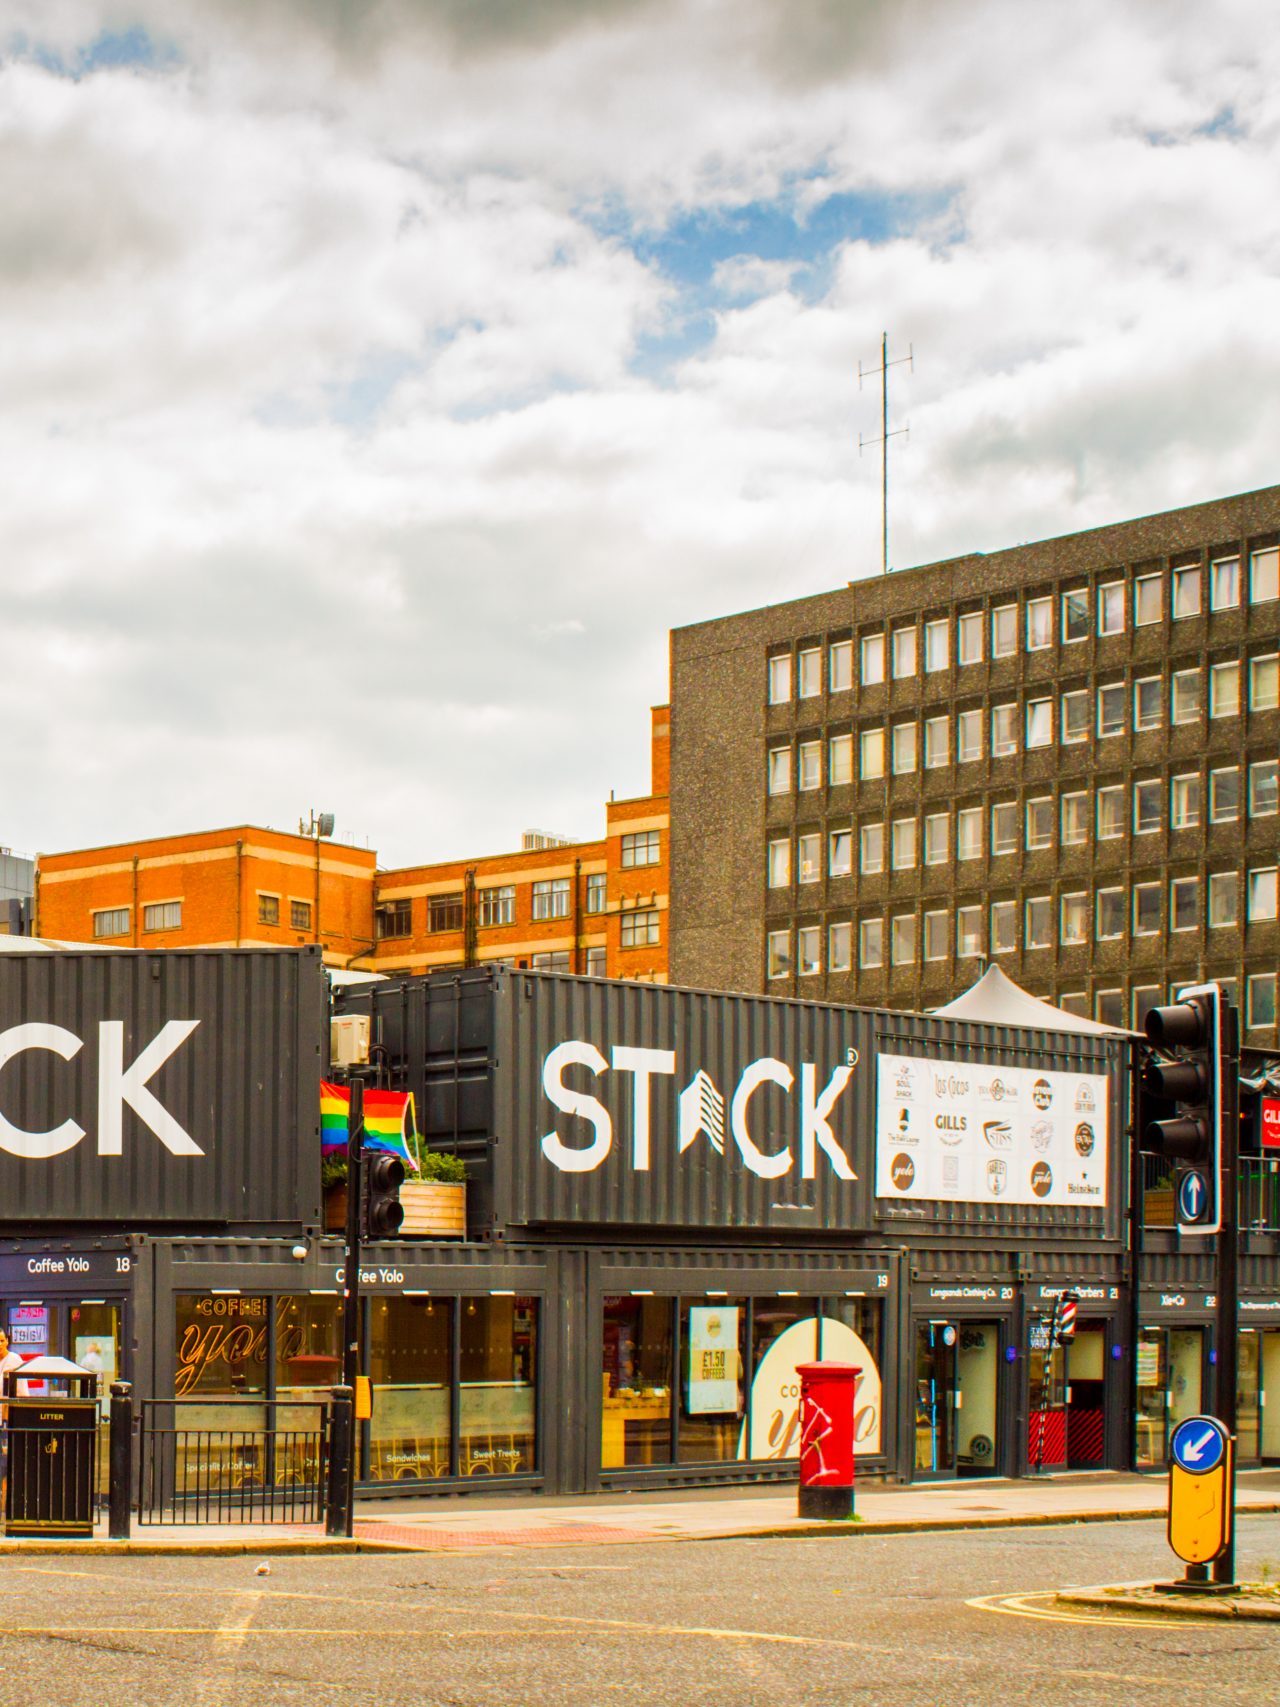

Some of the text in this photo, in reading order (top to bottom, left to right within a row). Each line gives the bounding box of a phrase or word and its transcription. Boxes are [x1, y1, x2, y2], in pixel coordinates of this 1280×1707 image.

[1263, 1109, 1280, 1123] GIL
[935, 1114, 967, 1131] GILLS
[28, 1257, 130, 1273] Coffee Yolo 18
[335, 1268, 404, 1283] Cfee Yolo
[878, 1275, 888, 1287] 19
[1001, 1288, 1014, 1299] 20
[1109, 1288, 1119, 1299] 21
[1205, 1296, 1217, 1307] 22
[704, 1351, 725, 1368] £1.50
[386, 1453, 431, 1463] Sandwiches
[473, 1449, 520, 1459] Sweet Treats
